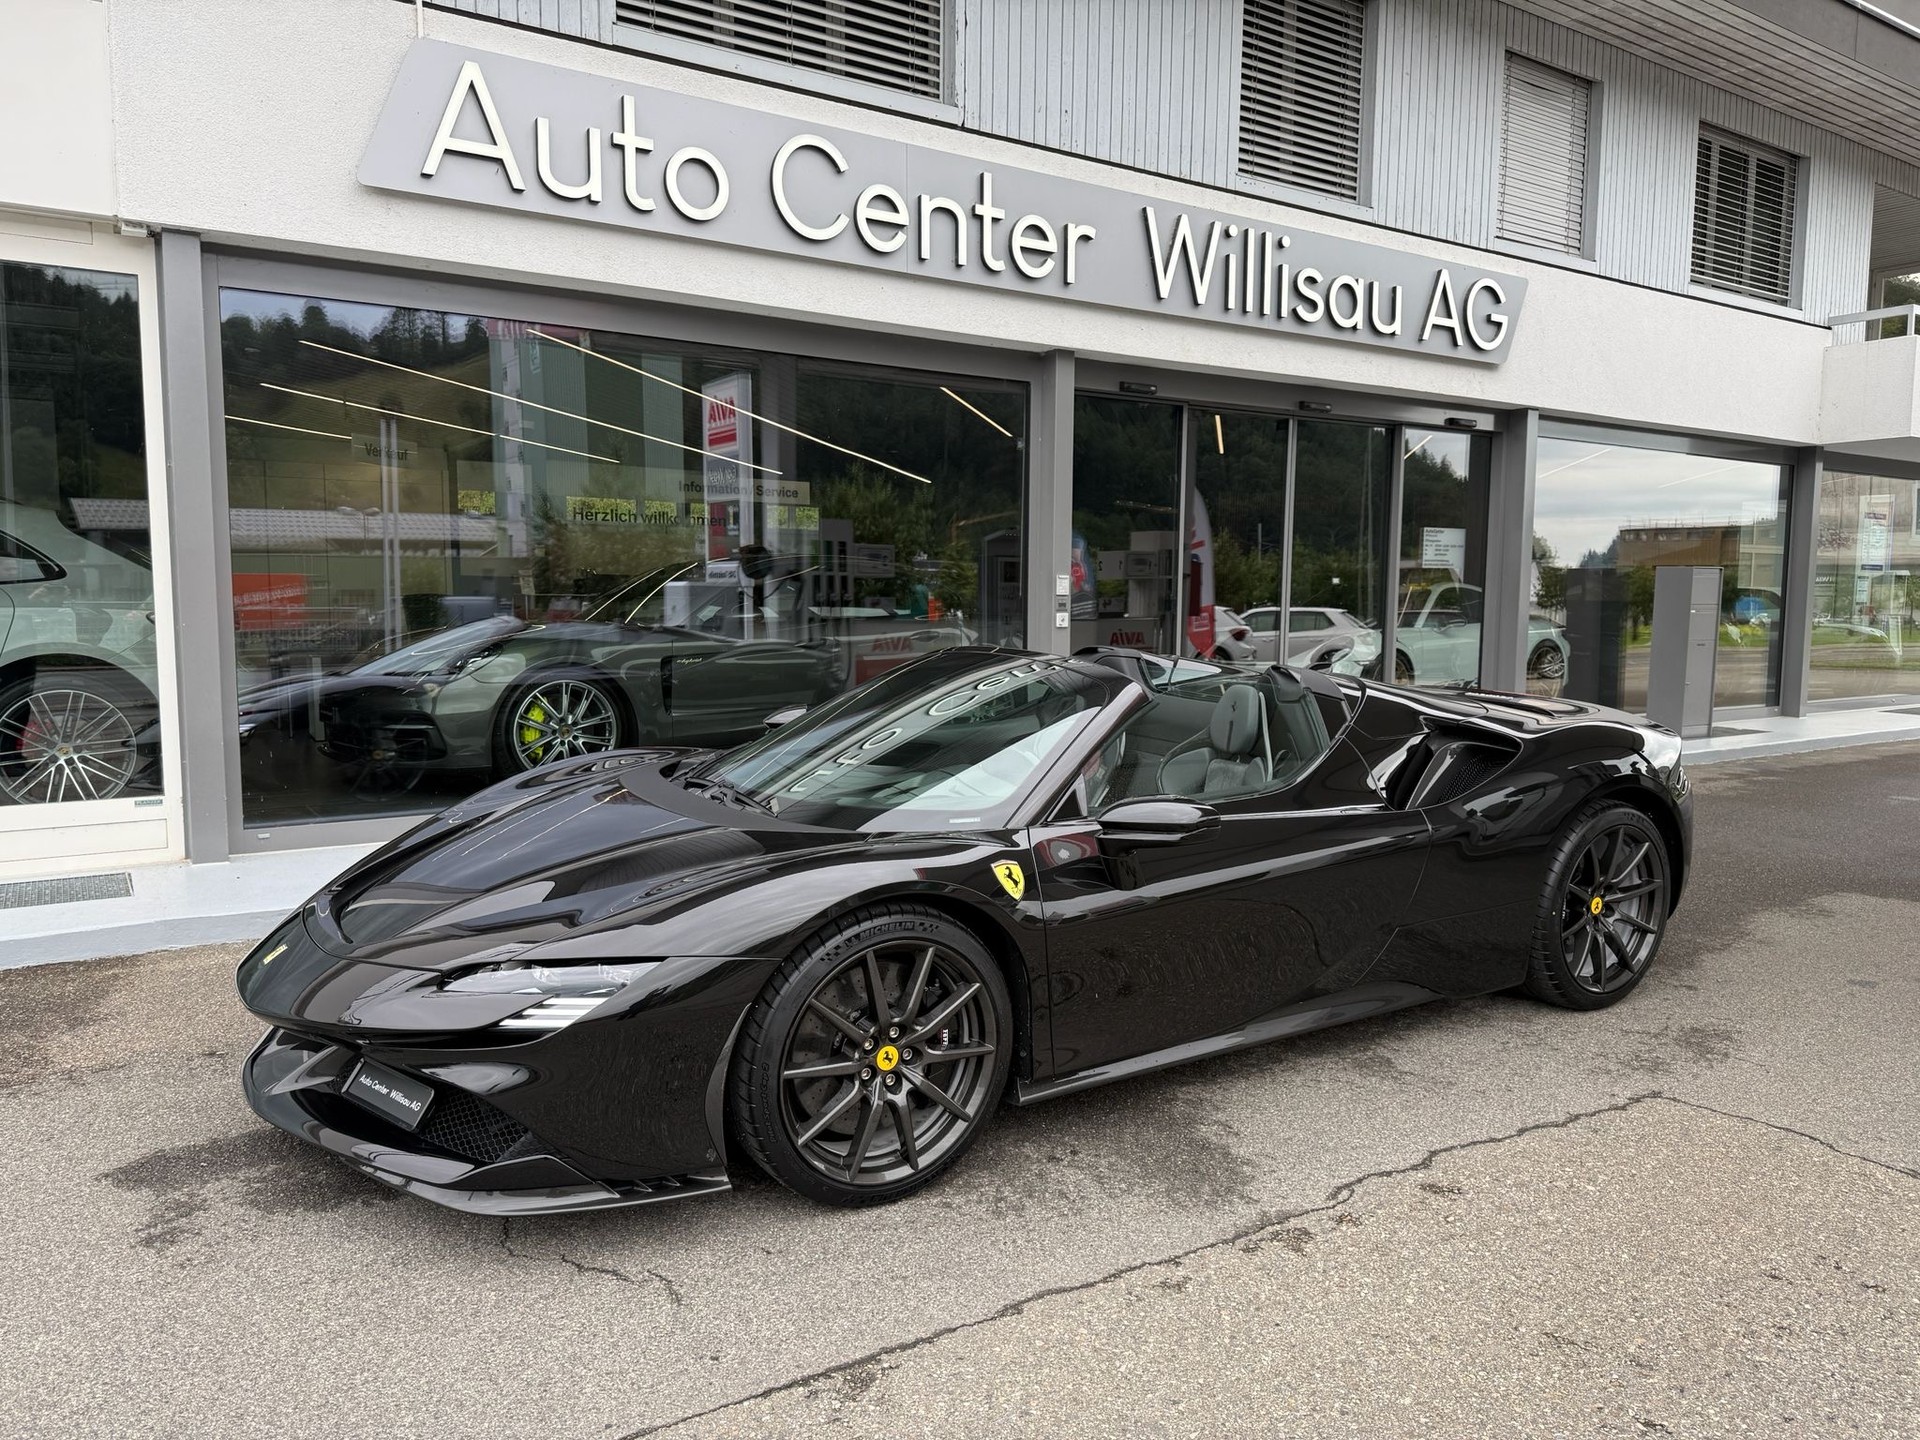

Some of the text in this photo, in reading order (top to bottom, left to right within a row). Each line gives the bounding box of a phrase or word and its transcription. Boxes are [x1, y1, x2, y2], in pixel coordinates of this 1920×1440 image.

[421, 60, 1510, 352] Auto Center Willisau AG
[678, 480, 748, 497] Information
[755, 484, 799, 499] Service
[572, 505, 637, 524] Herzlich
[858, 920, 915, 940] MICHELIN
[359, 1074, 421, 1111] Auto Center Willisau AG
